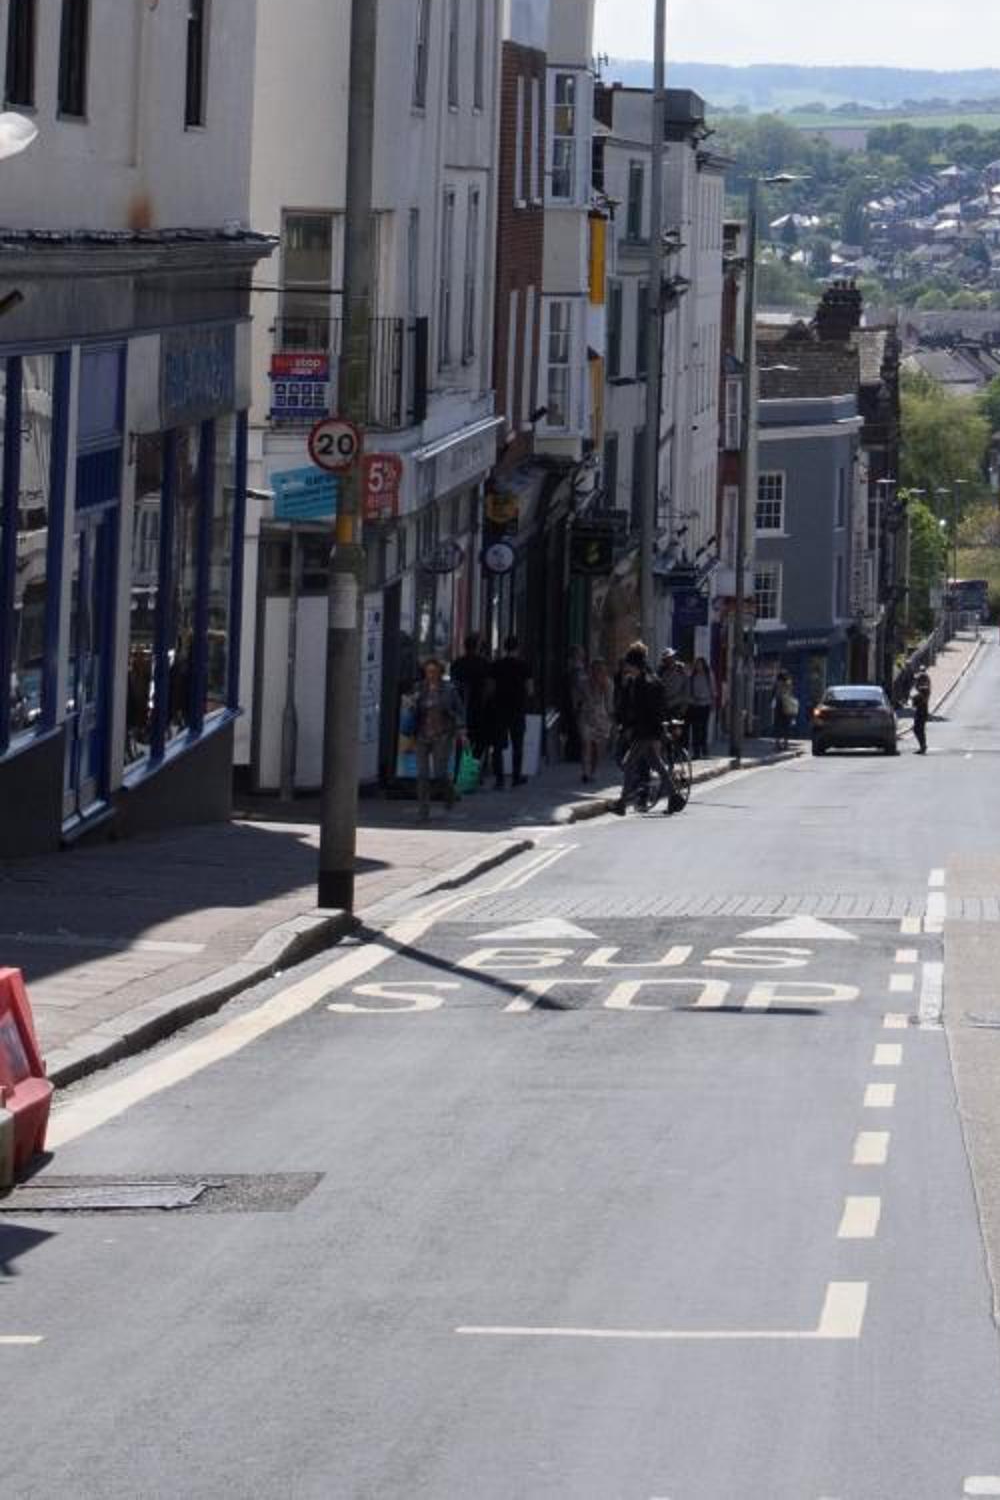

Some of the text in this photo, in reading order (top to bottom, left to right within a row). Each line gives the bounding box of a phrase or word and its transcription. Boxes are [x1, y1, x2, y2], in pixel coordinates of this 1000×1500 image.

[318, 433, 355, 455] 20
[455, 945, 814, 969] BUS
[326, 979, 861, 1013] STOP
